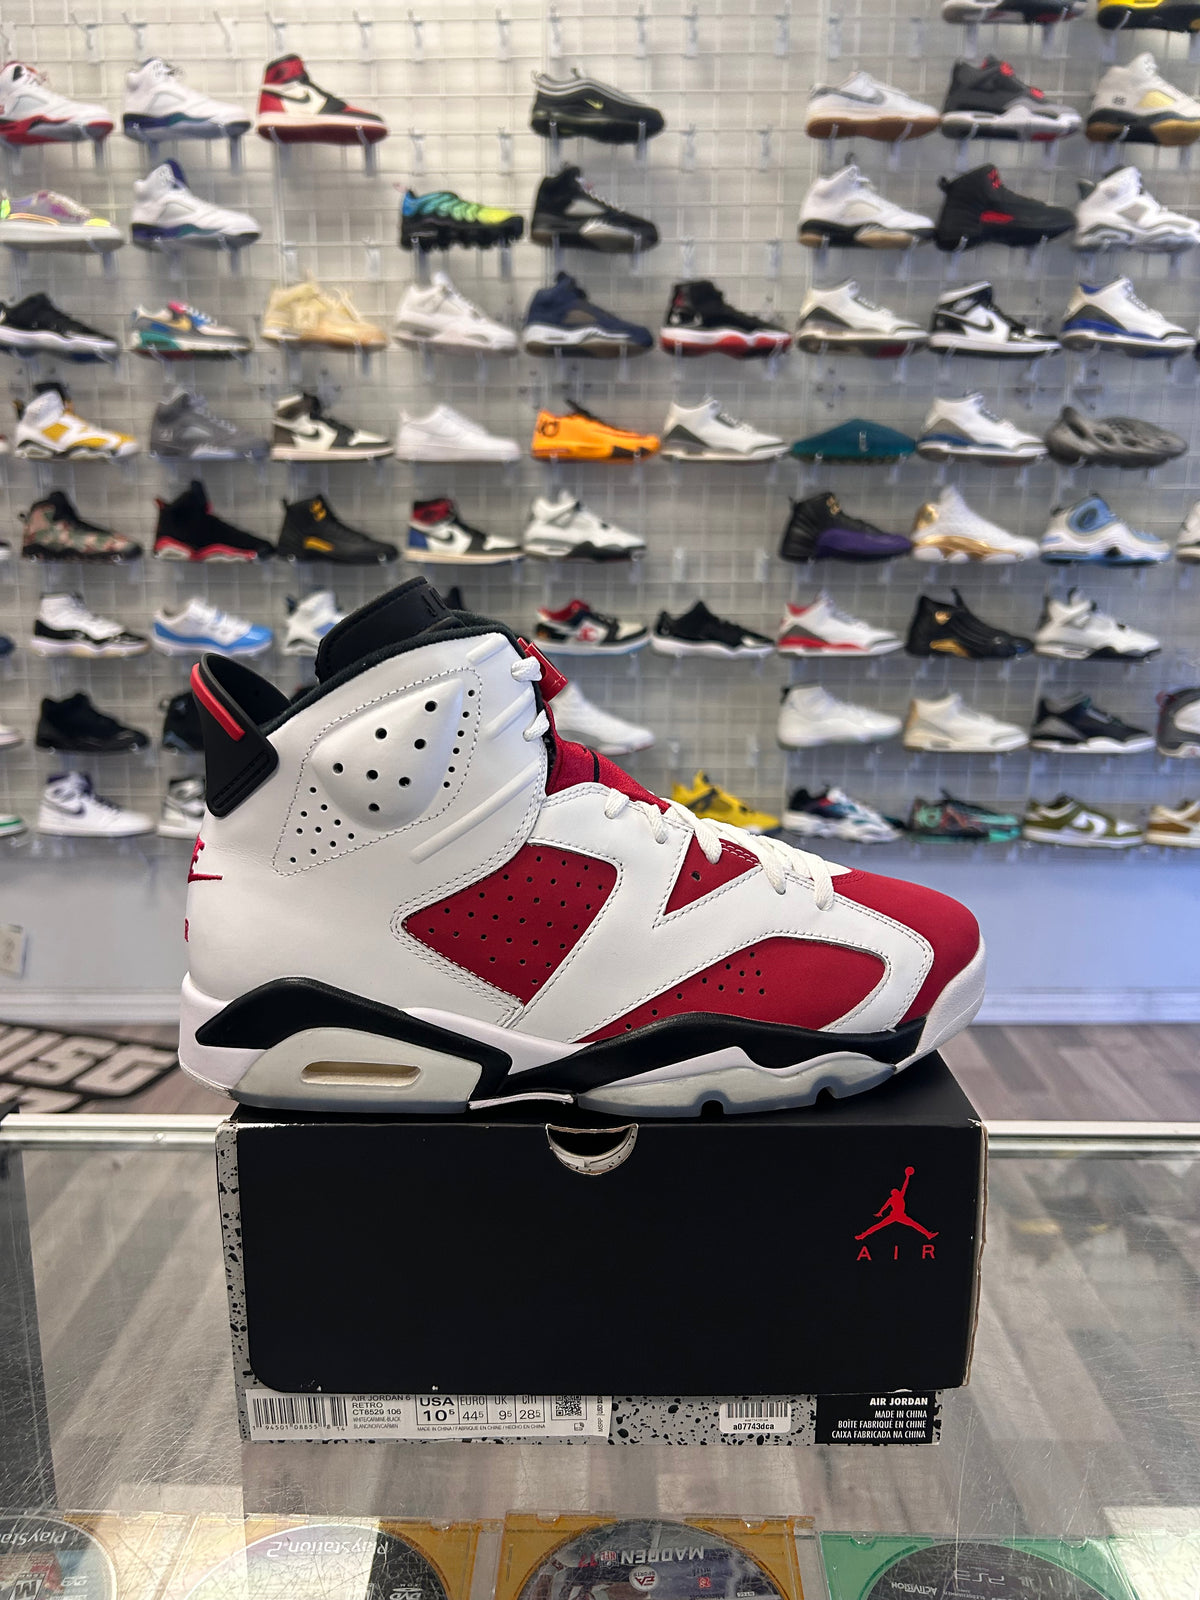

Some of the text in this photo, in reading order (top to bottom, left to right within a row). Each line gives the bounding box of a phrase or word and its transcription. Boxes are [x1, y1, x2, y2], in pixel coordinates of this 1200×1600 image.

[857, 1244, 936, 1261] AIR
[420, 1396, 455, 1407] USA
[460, 1396, 485, 1406] EURO
[494, 1395, 508, 1405] UK
[869, 1397, 928, 1406] AIR JORDAN
[874, 1410, 928, 1418] MADE IN CHINA
[895, 1420, 904, 1429] EN
[906, 1420, 927, 1429] CHINE
[831, 1430, 926, 1439] CAIXA FABRICADA NA CHINA
[620, 1545, 705, 1565] MADDEN
